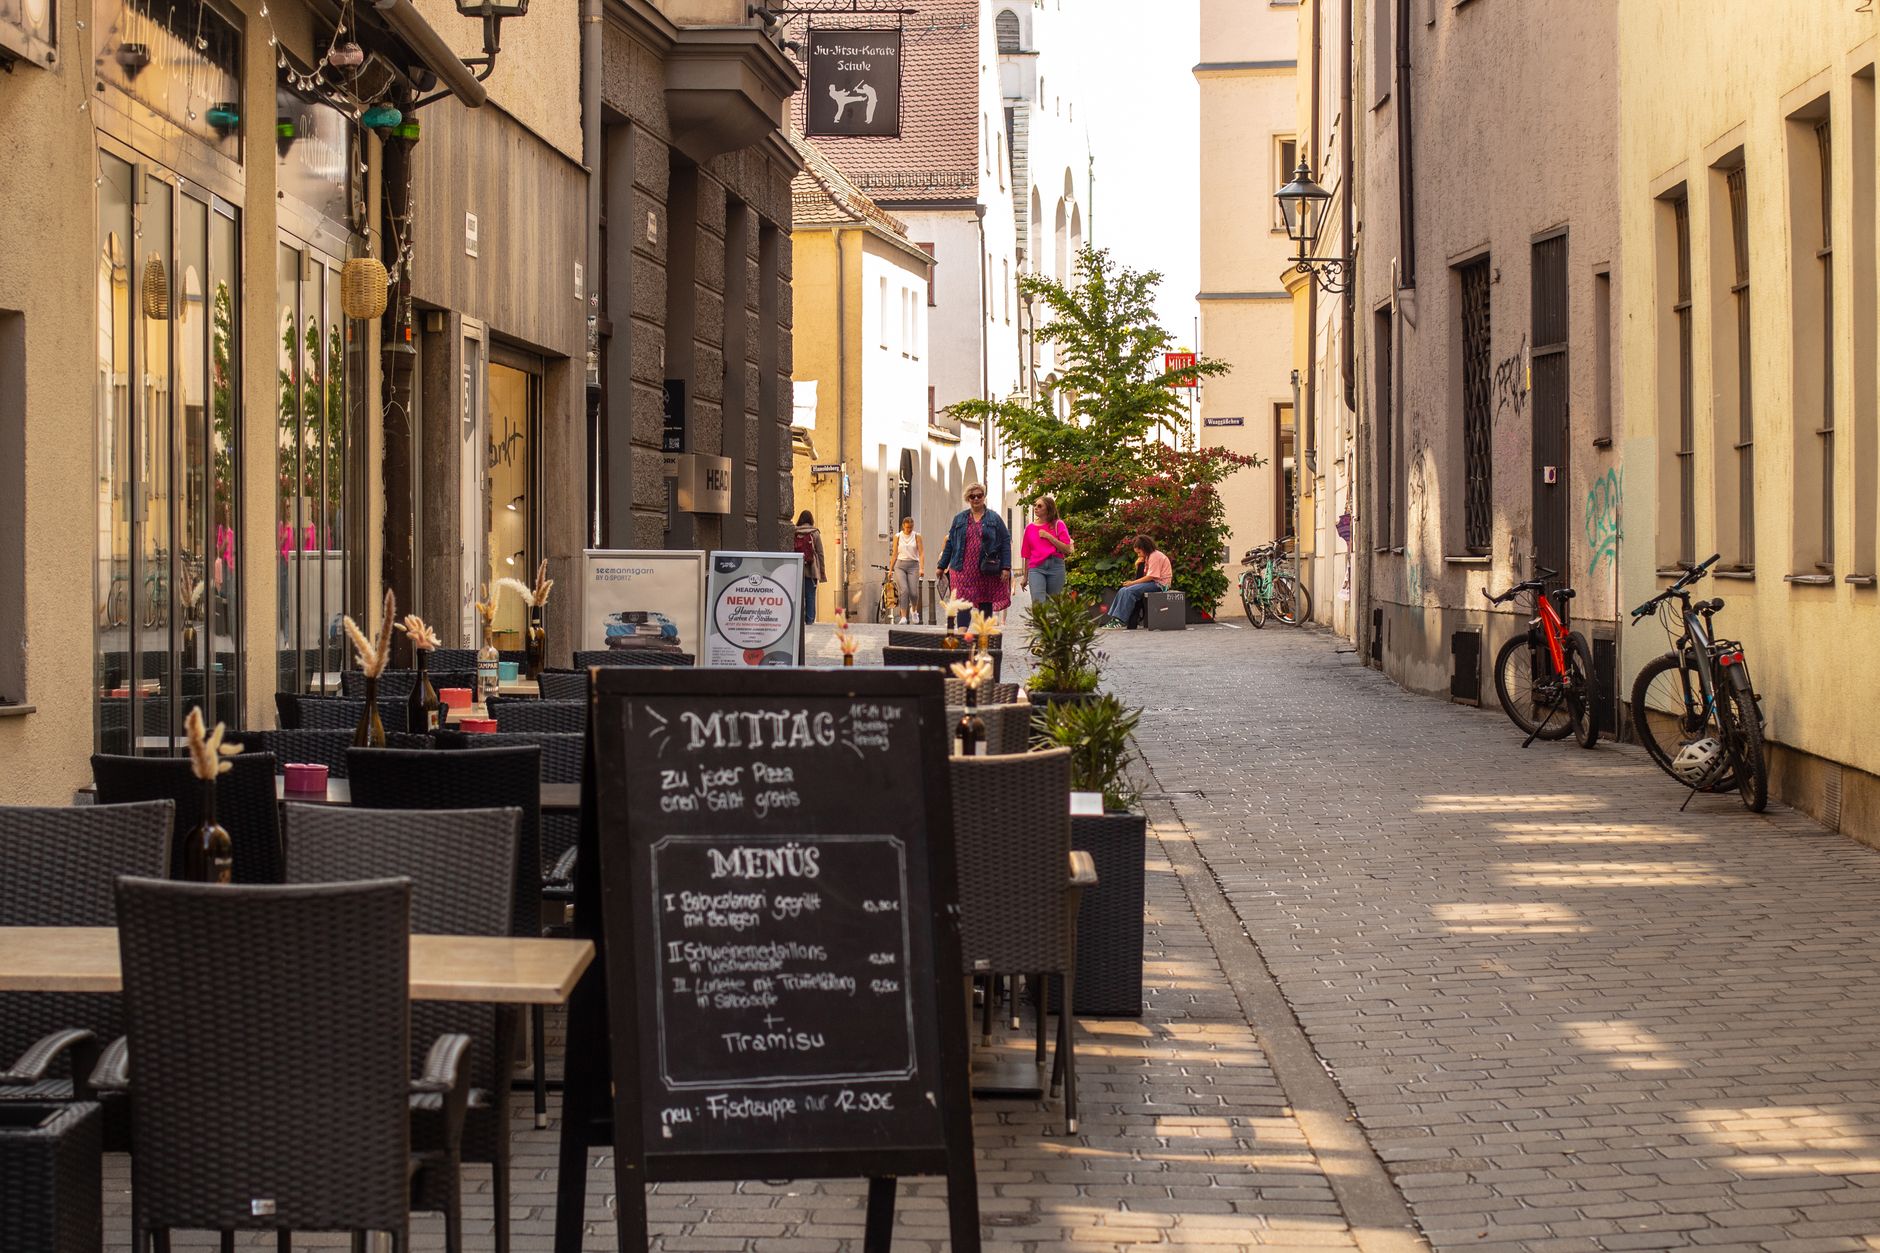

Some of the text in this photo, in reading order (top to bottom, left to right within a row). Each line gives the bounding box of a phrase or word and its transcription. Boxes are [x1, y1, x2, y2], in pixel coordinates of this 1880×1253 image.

[814, 45, 895, 56] Jiu-Jitsu-Karate
[837, 60, 871, 71] Schule
[596, 567, 655, 576] seemannsgarn
[726, 596, 784, 606] NEW YOU
[680, 709, 836, 751] MITTAG
[695, 765, 744, 797] jeder
[752, 762, 794, 783] Pizza
[660, 787, 800, 818] einen Salat gratis
[708, 843, 820, 879] MENÜS
[771, 892, 821, 920] gegrillt
[683, 911, 703, 928] mit
[684, 941, 828, 962] Schweinemedaillons
[753, 978, 776, 993] mit
[721, 1027, 825, 1053] Tiramisu
[706, 1093, 797, 1122] Fischsuppe
[804, 1094, 829, 1112] nur
